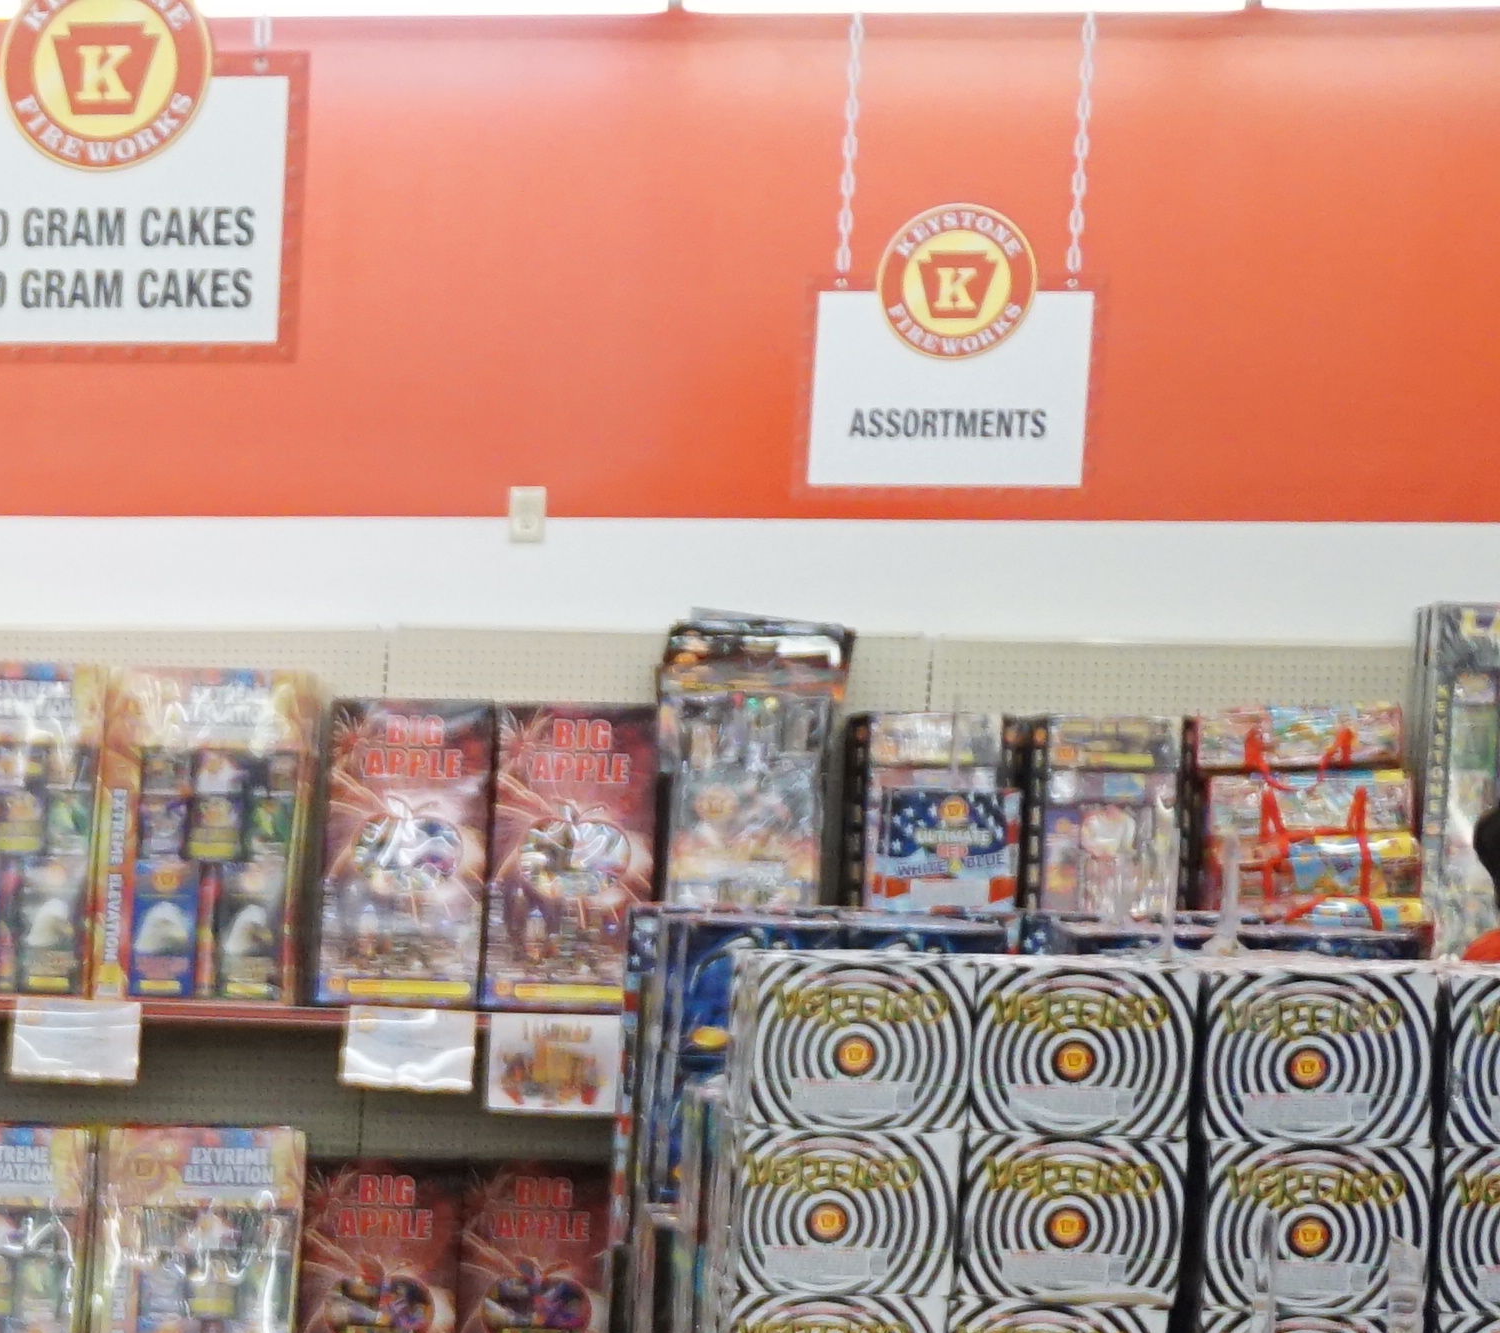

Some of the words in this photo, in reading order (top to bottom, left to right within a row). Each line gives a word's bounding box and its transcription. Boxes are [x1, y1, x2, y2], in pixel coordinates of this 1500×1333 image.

[76, 45, 132, 101] K
[15, 92, 195, 162] FIREWORKS
[23, 208, 125, 247] GRAM
[141, 207, 255, 247] CAKES
[896, 210, 1023, 258] KEYSTONE
[20, 269, 123, 308] GRAM
[137, 268, 253, 308] CAKES
[935, 267, 977, 311] K
[888, 303, 1023, 355] FIREWORKS
[848, 408, 1047, 439] ASSORTMENTS
[386, 715, 444, 745] BIG
[552, 719, 612, 749] BIG
[364, 749, 462, 779] APPLE
[531, 753, 631, 783] APPLE
[898, 860, 947, 875] WHITE
[190, 1146, 269, 1165] EXTREME
[183, 1164, 274, 1185] ELEVATION
[743, 1152, 919, 1192] VERTIGO
[984, 1155, 1161, 1197] VERTIGO
[1224, 1163, 1405, 1204] VERTIGO
[357, 1174, 416, 1206] BIG
[514, 1176, 573, 1207] BIG
[336, 1209, 433, 1240] APPLE
[492, 1210, 591, 1241] APPLE
